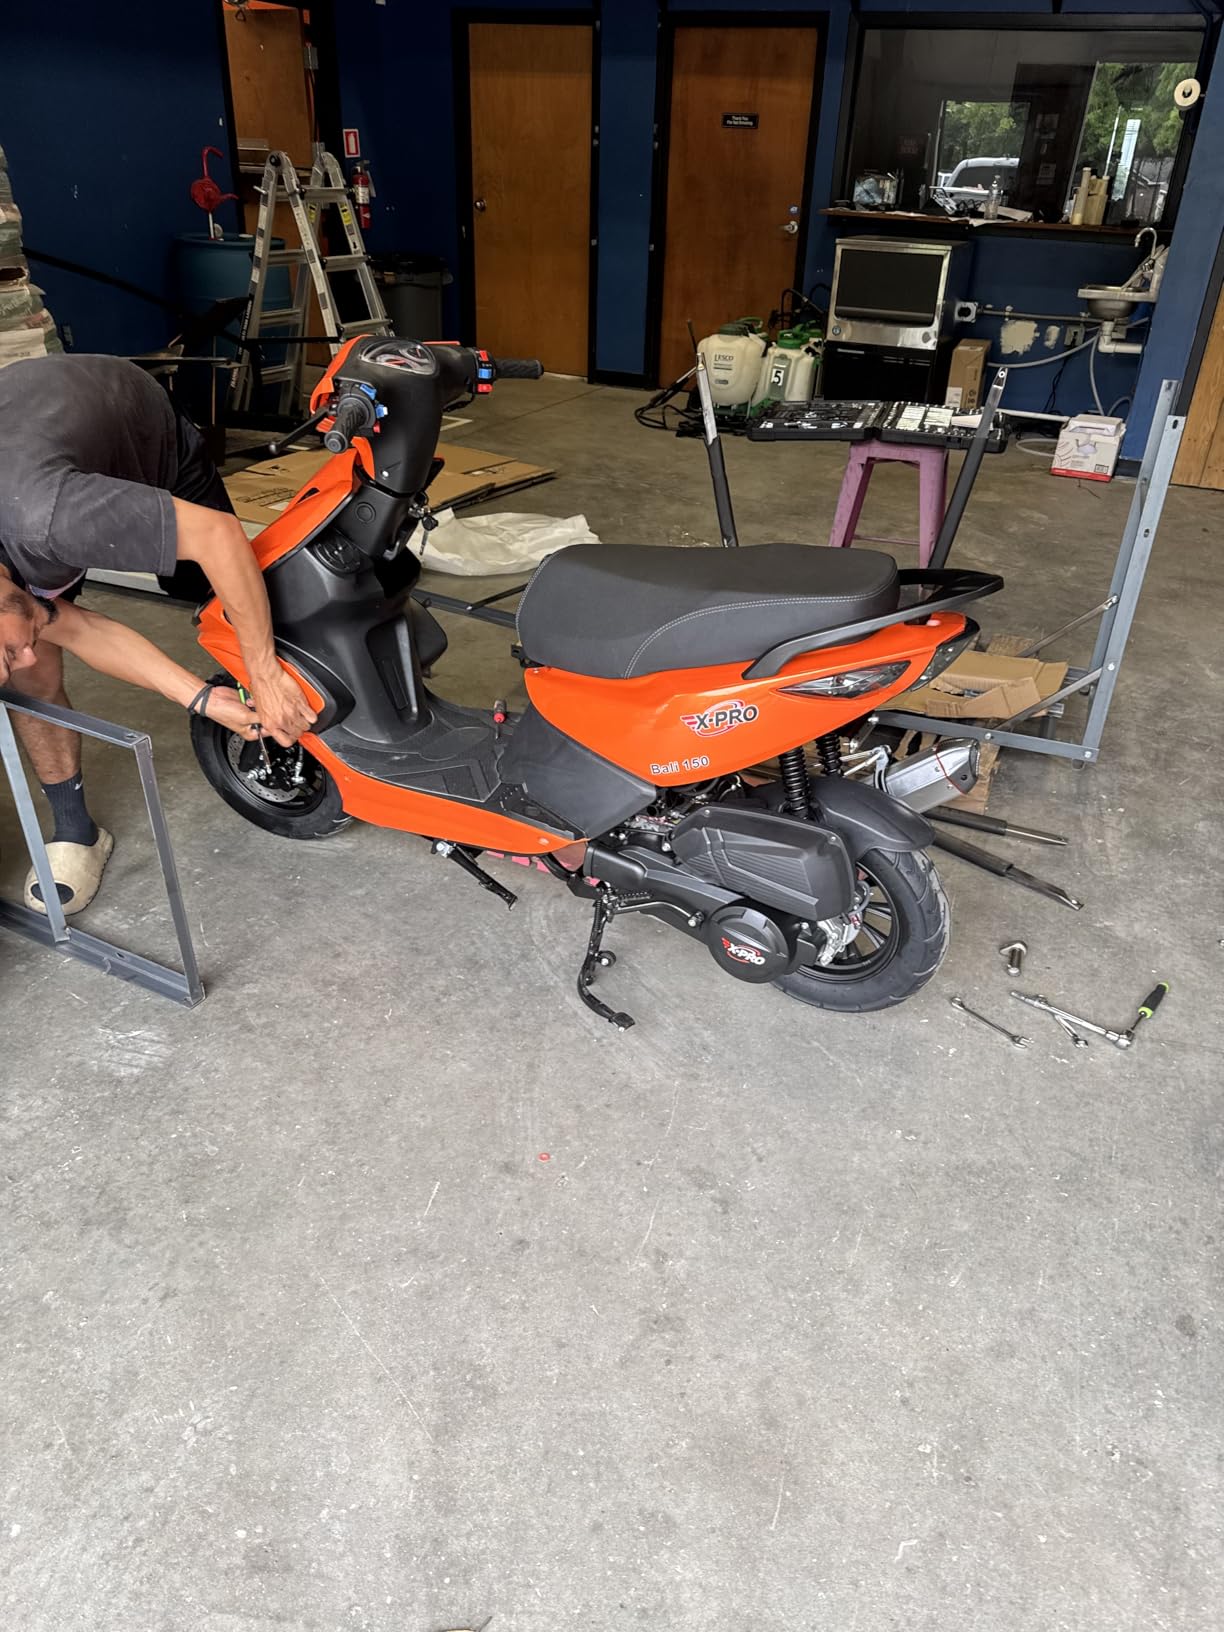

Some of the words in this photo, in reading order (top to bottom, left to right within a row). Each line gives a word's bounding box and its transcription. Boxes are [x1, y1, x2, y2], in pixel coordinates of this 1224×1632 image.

[773, 370, 782, 385] 5
[695, 706, 758, 730] X-PRO
[651, 761, 679, 775] Bali
[683, 756, 709, 770] 150
[727, 942, 766, 965] X-PRO
